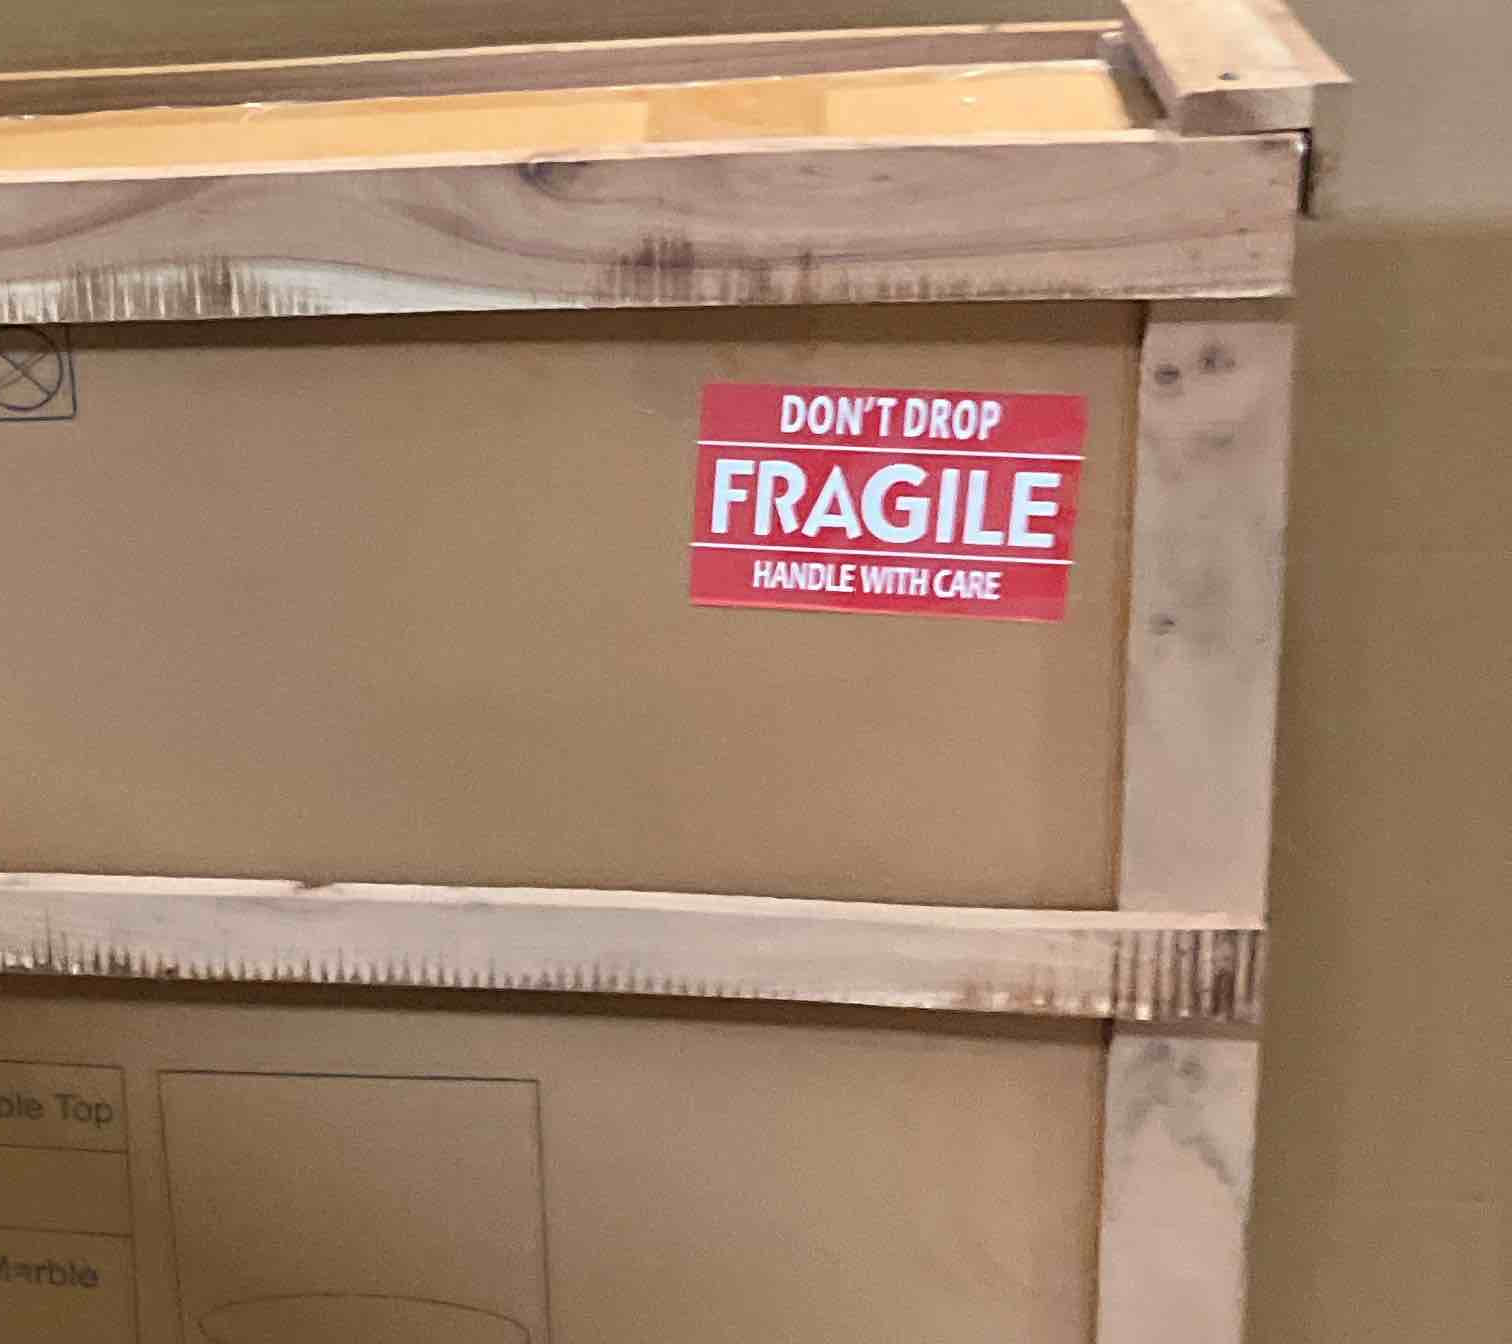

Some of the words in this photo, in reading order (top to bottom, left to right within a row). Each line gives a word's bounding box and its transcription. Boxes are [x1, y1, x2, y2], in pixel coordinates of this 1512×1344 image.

[780, 394, 899, 437] DON'T
[903, 397, 1002, 441] DROP
[710, 458, 1063, 549] FRAGILE
[751, 560, 857, 594] HANDLE
[859, 565, 929, 596] WITH
[933, 569, 1005, 601] CARE
[54, 1093, 115, 1129] Top
